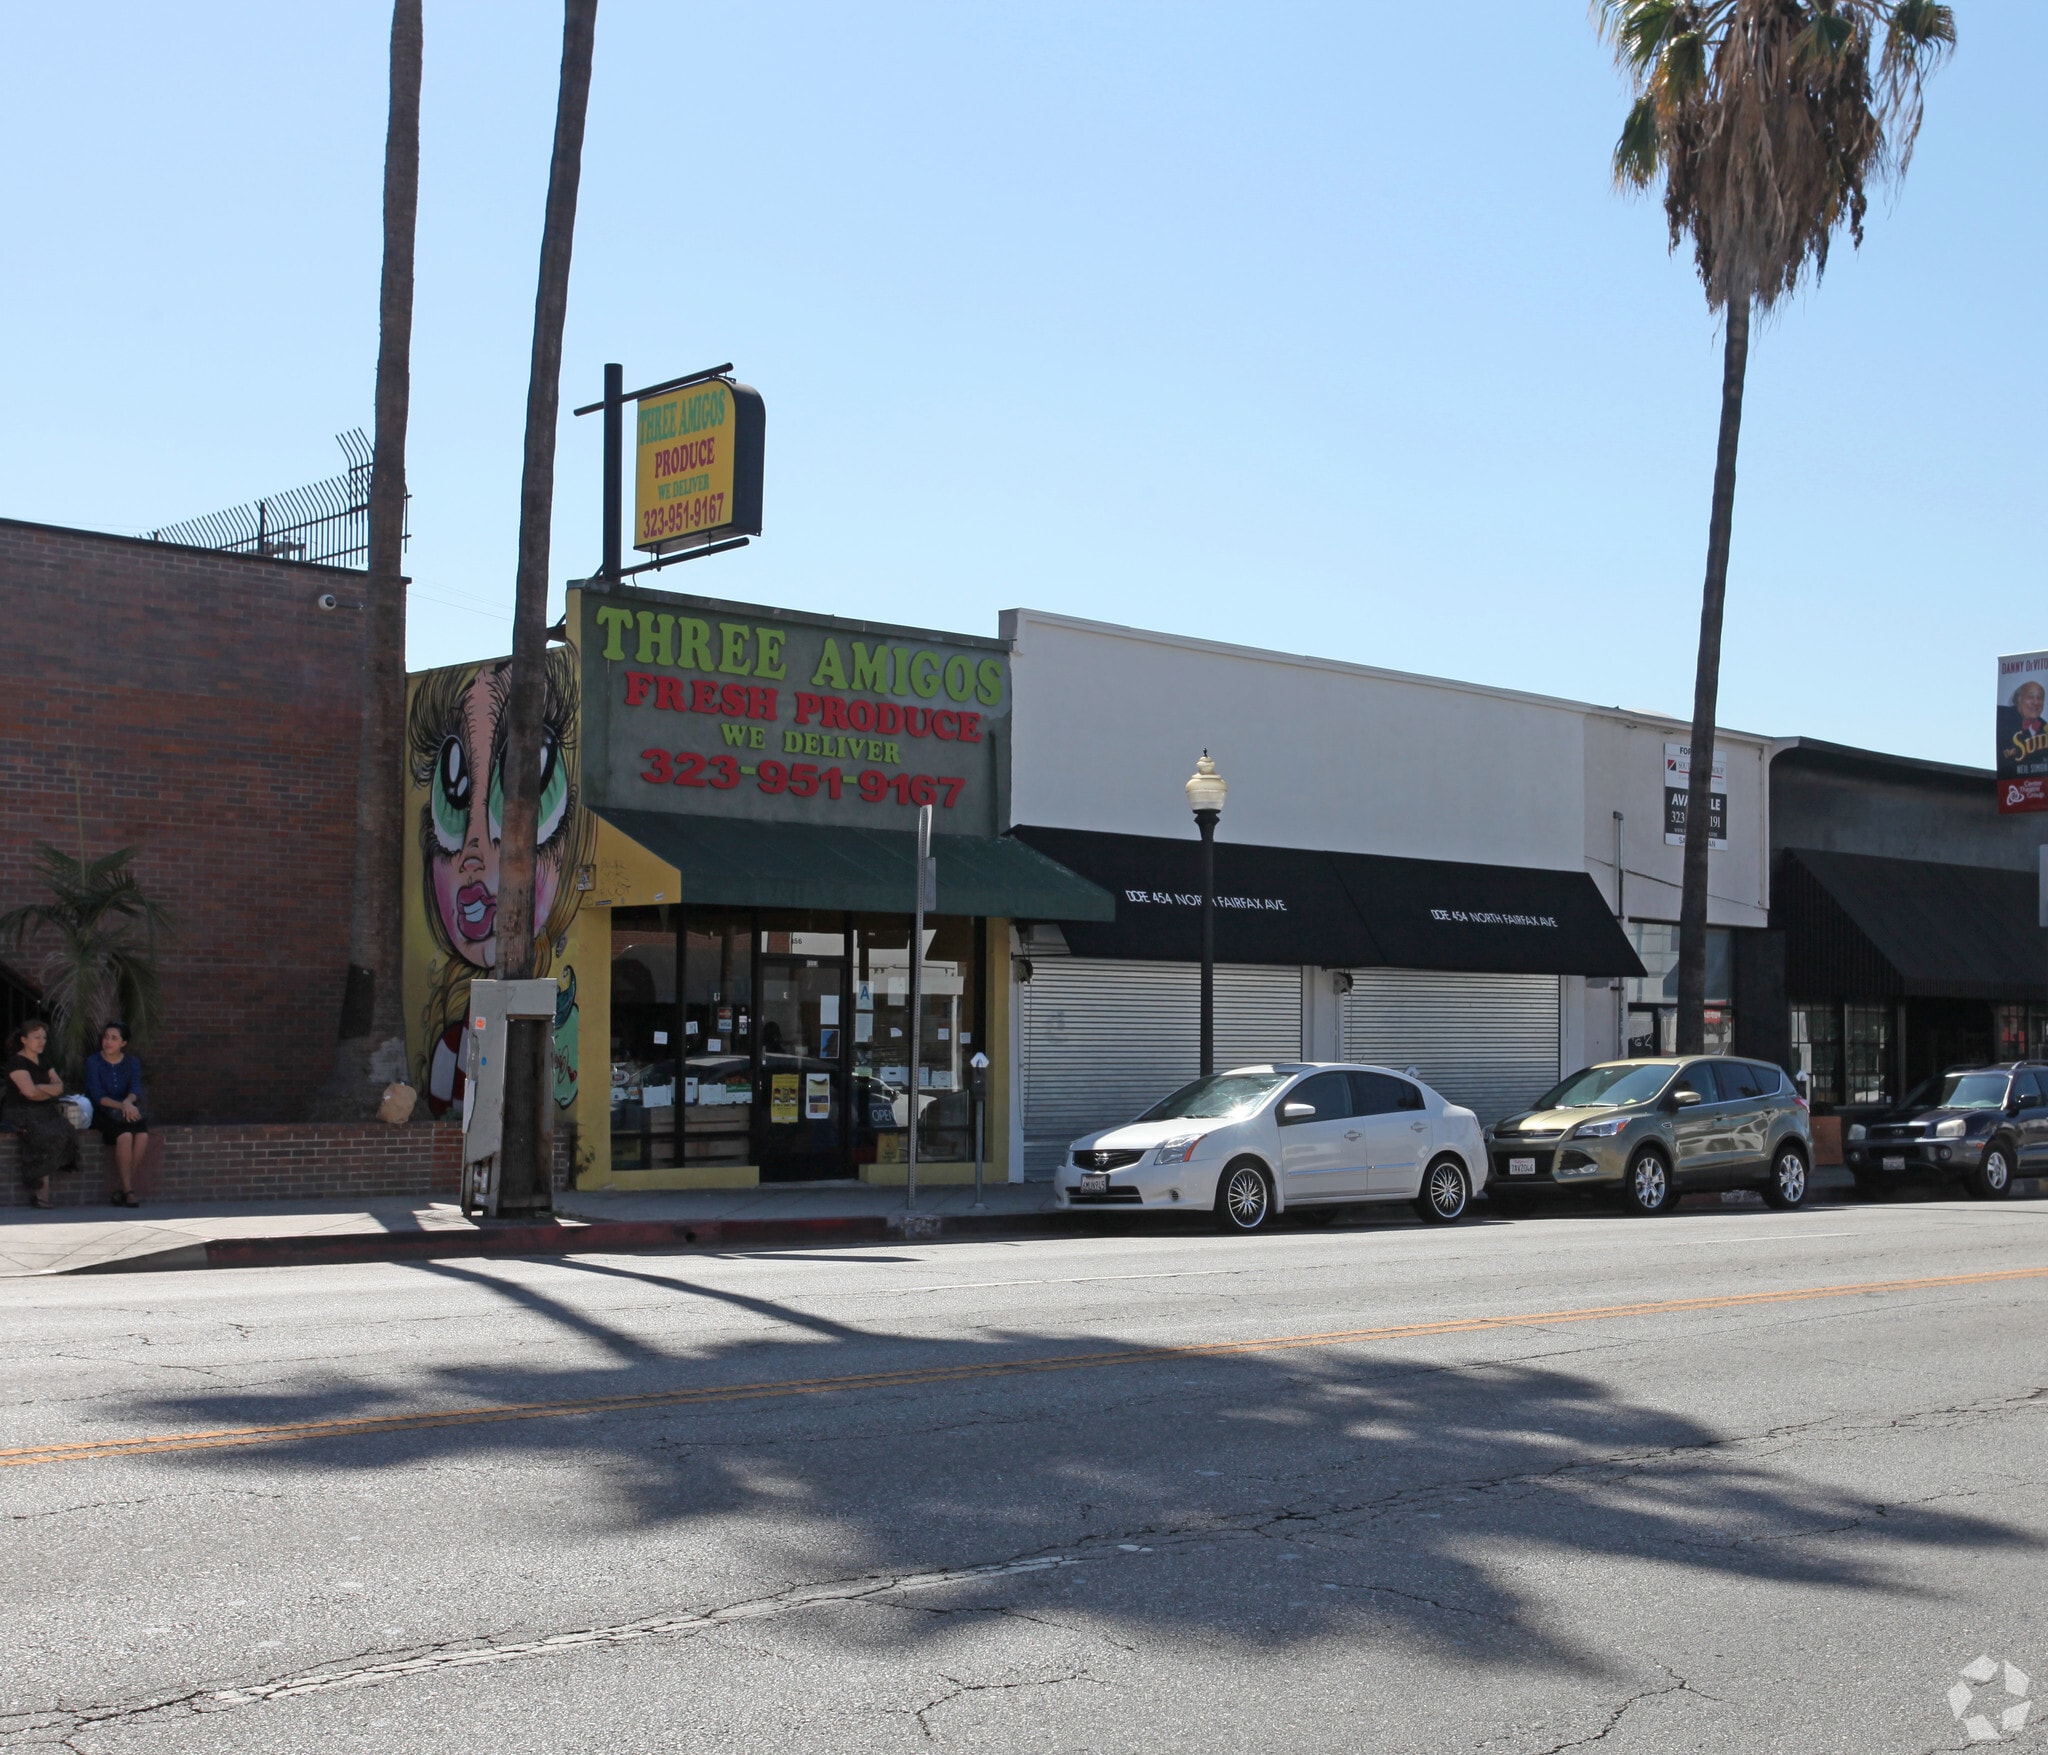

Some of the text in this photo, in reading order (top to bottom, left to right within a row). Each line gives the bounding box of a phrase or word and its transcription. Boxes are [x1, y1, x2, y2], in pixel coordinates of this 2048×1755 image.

[639, 388, 726, 446] THREE AMIGOS
[654, 436, 715, 479] PRODUCE
[657, 473, 710, 501] WE DELIVER
[643, 492, 724, 539] 323-951-9167
[596, 605, 1003, 706] THREE AMIGOS
[2001, 661, 2024, 675] DANNY
[624, 671, 983, 743] FRESH PRODUCE
[720, 723, 901, 764] WE DELIVER
[640, 748, 967, 808] 323-951-9167
[1152, 892, 1173, 904] 454
[1174, 893, 1218, 907] NOR
[1217, 896, 1264, 910] FAIRFAX
[1264, 899, 1288, 911] AVE
[1451, 911, 1469, 922] 454
[1469, 912, 1503, 924] NORTH
[1502, 914, 1541, 926] FAIRFAX
[1539, 917, 1558, 928] AVE
[860, 985, 870, 1000] A
